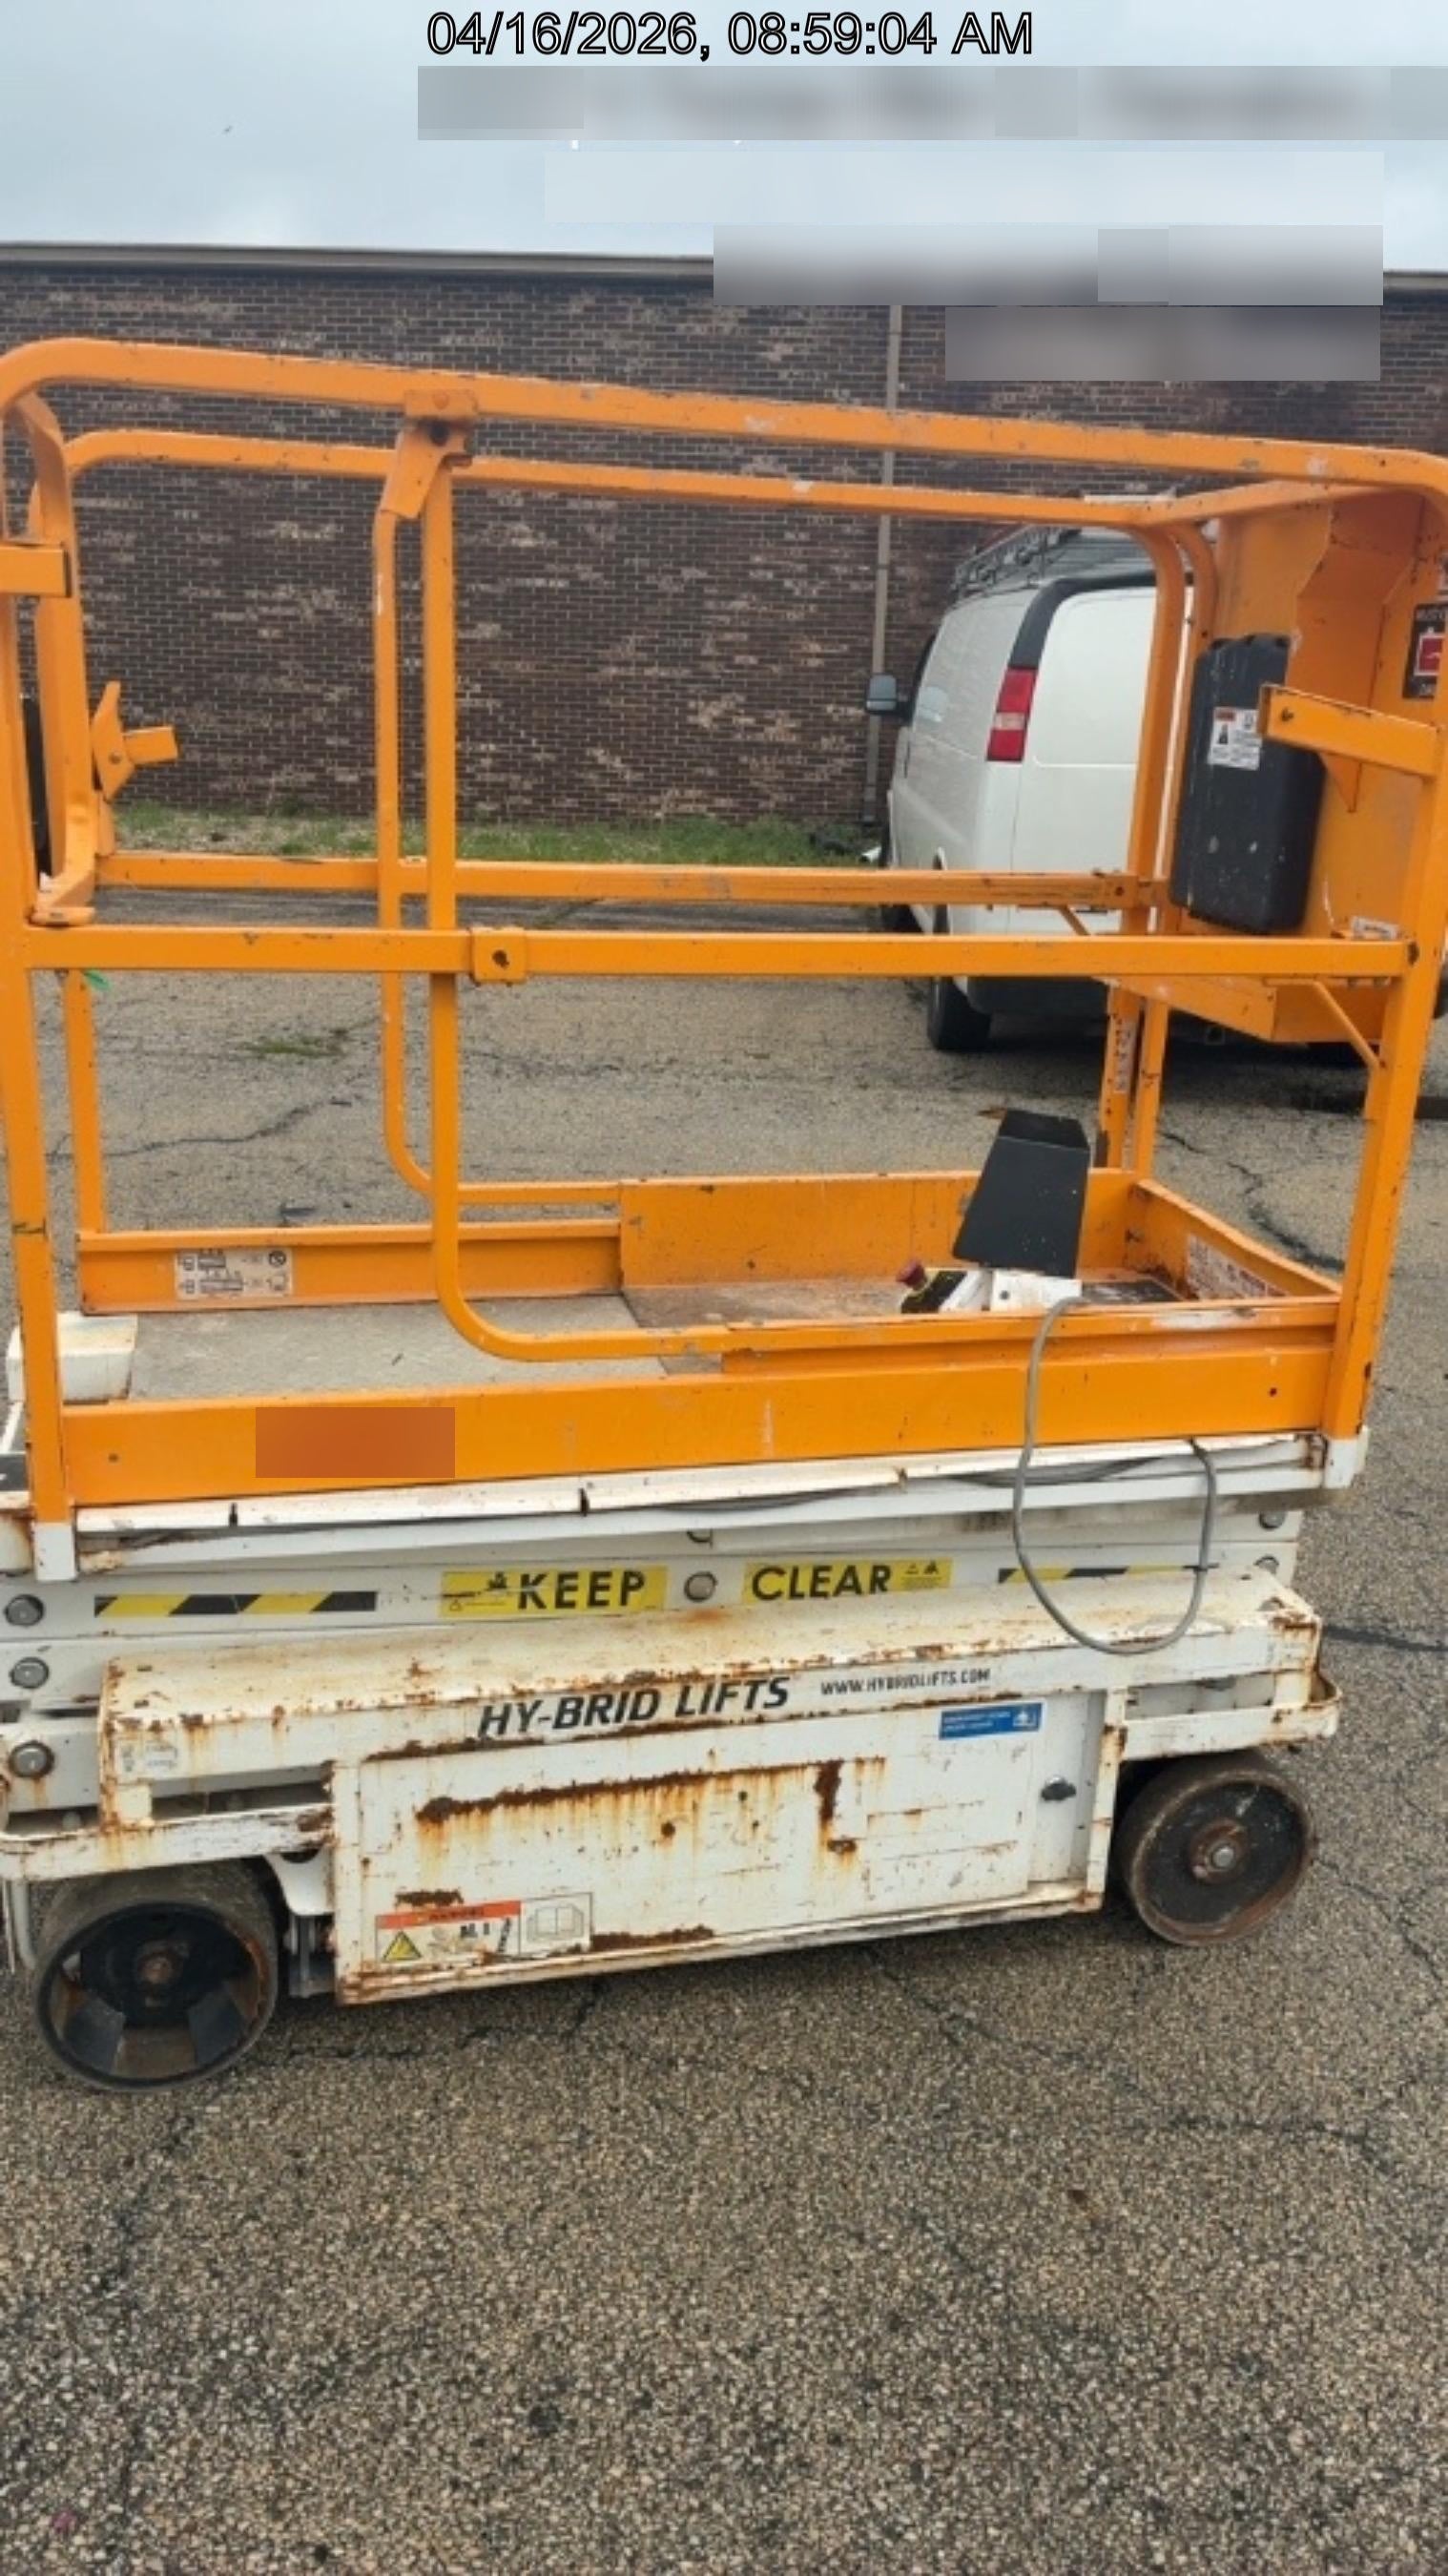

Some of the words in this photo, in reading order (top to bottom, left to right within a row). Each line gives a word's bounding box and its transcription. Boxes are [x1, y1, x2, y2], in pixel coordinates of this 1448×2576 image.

[517, 1570, 646, 1610] KEEP
[752, 1564, 892, 1601] CLEAR
[478, 1687, 661, 1737] HY-BRID
[674, 1675, 791, 1718] LIFTS
